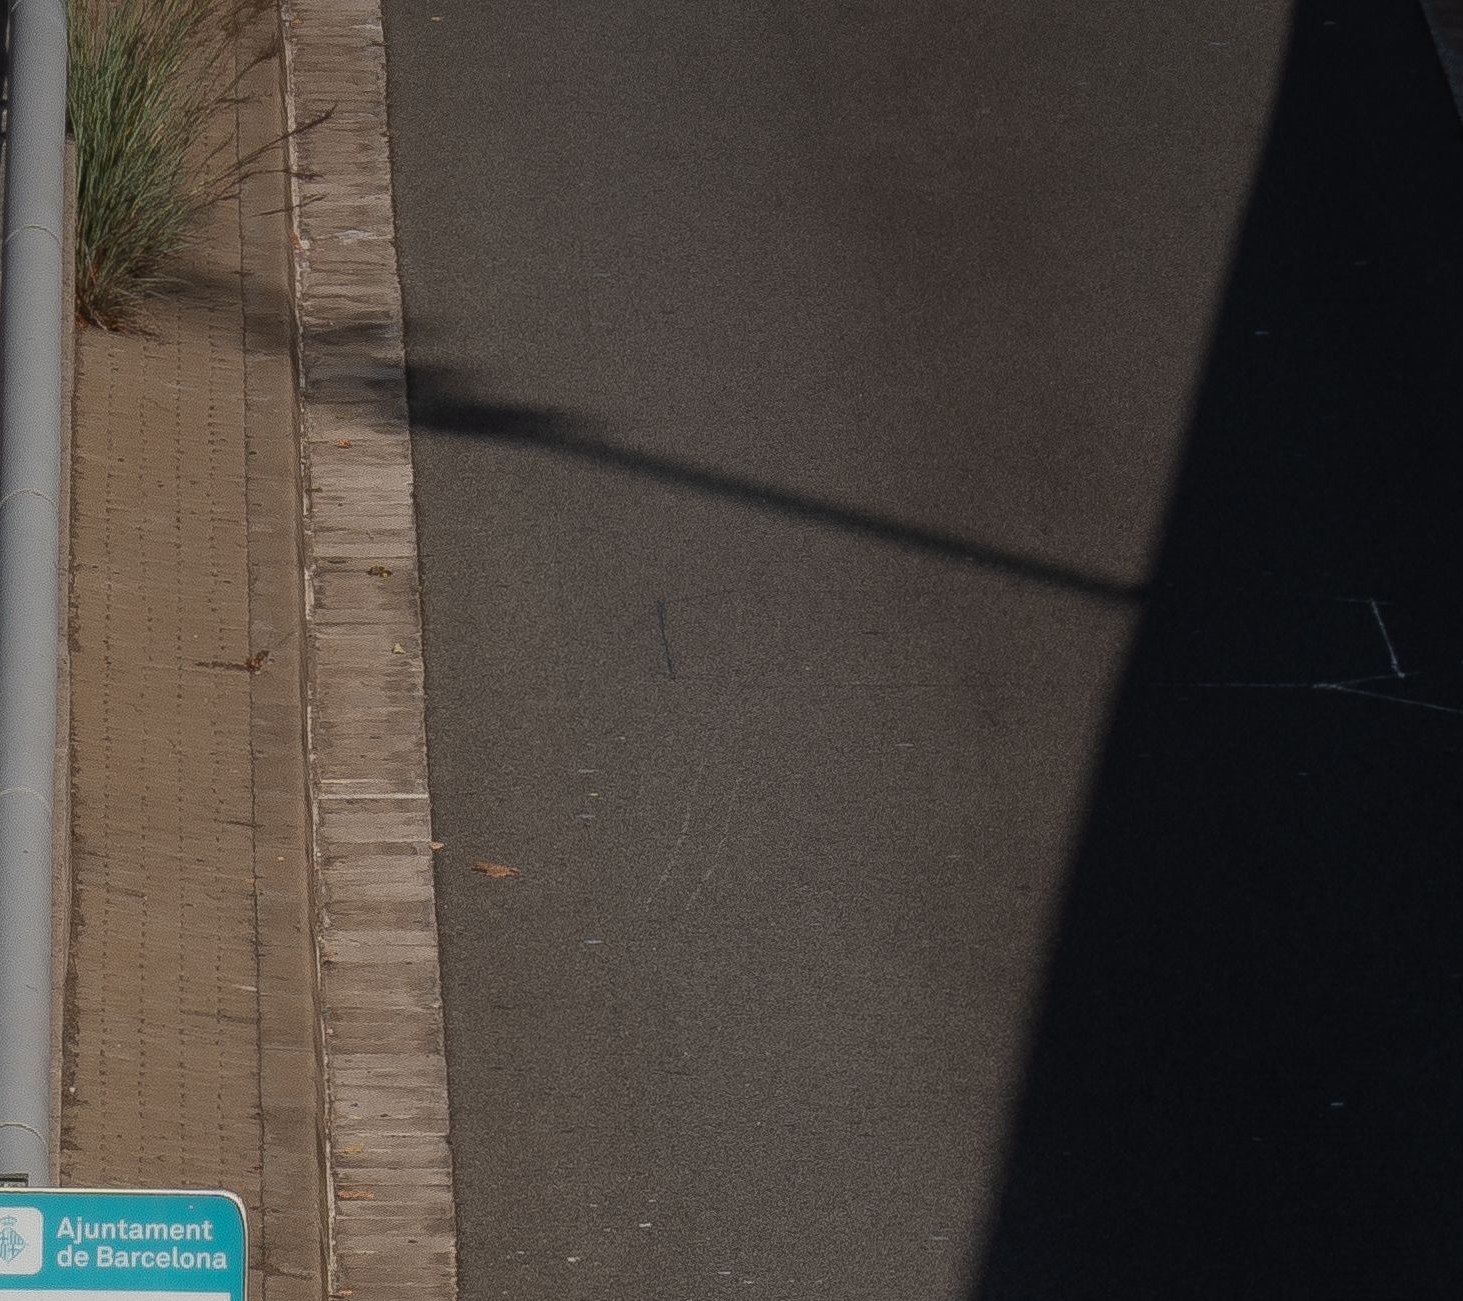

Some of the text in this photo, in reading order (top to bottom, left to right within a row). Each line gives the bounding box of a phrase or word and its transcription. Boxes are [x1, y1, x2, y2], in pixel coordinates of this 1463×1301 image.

[56, 1216, 214, 1244] Ajuntament
[56, 1247, 228, 1270] de Barcelona
